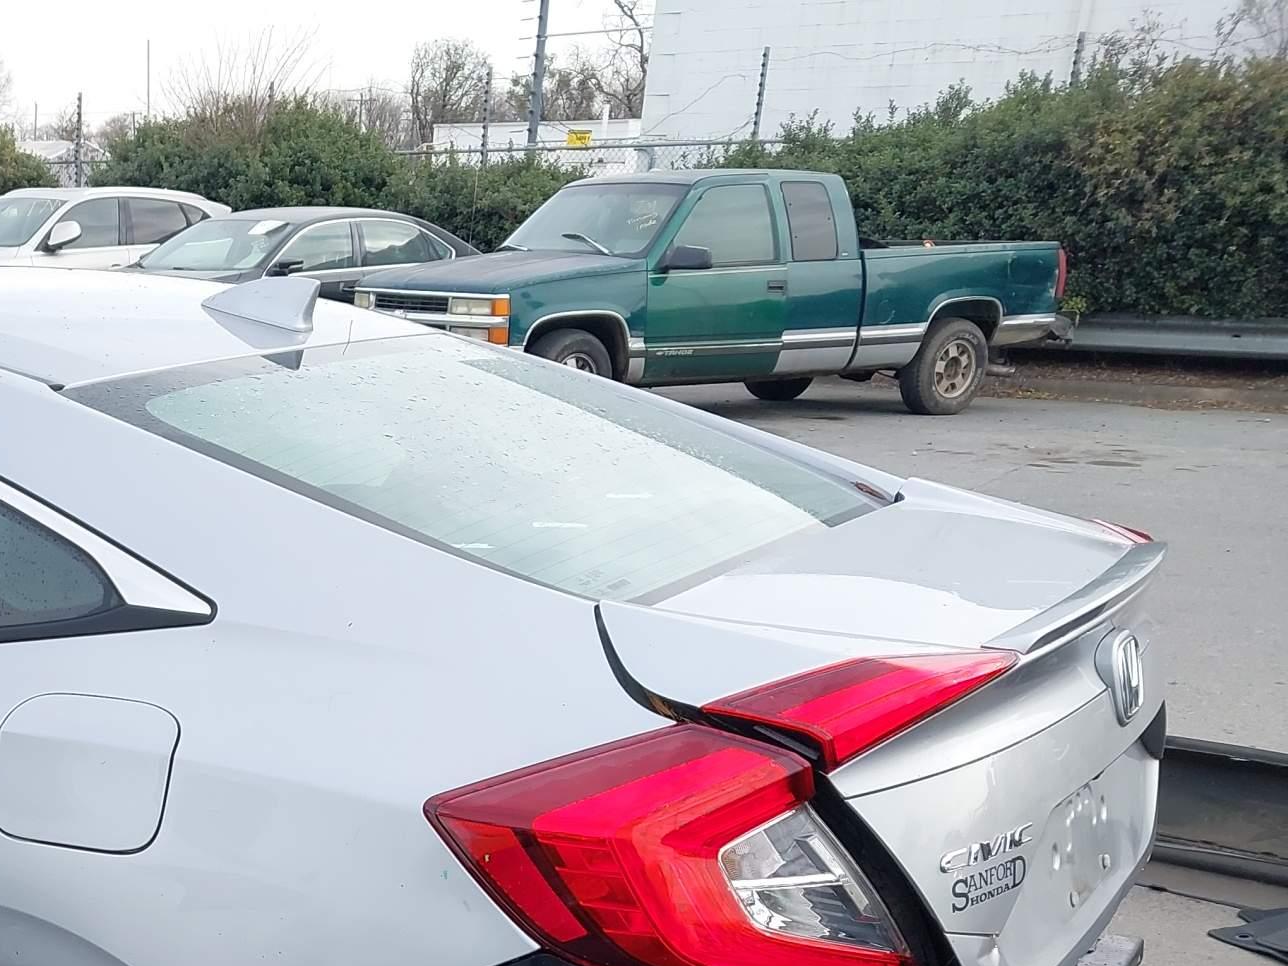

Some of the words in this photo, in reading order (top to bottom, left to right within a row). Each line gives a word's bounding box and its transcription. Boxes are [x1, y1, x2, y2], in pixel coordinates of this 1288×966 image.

[940, 822, 1033, 873] CIVIC
[952, 856, 1026, 913] SANFORD
[970, 883, 1013, 906] HONDA
